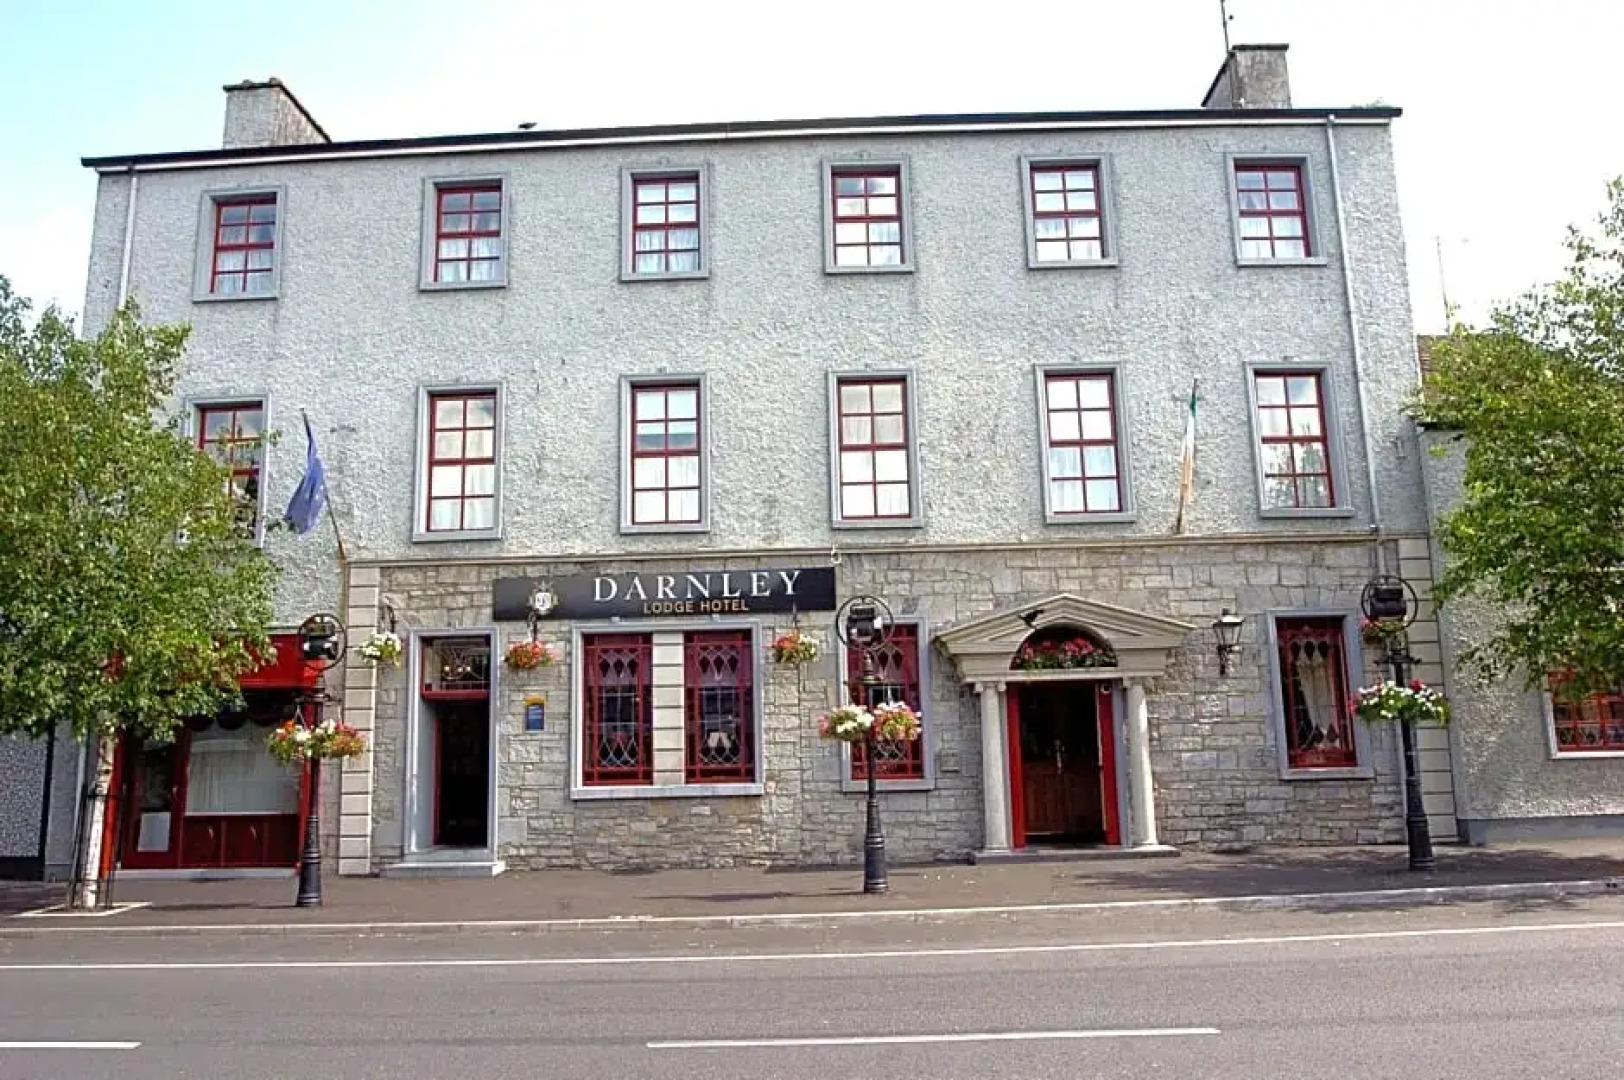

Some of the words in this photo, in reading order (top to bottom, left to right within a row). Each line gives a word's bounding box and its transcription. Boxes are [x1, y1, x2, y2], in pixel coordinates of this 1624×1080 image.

[593, 570, 802, 602] DARNLEY
[643, 601, 694, 615] LODGE
[700, 598, 749, 613] HOTEL
